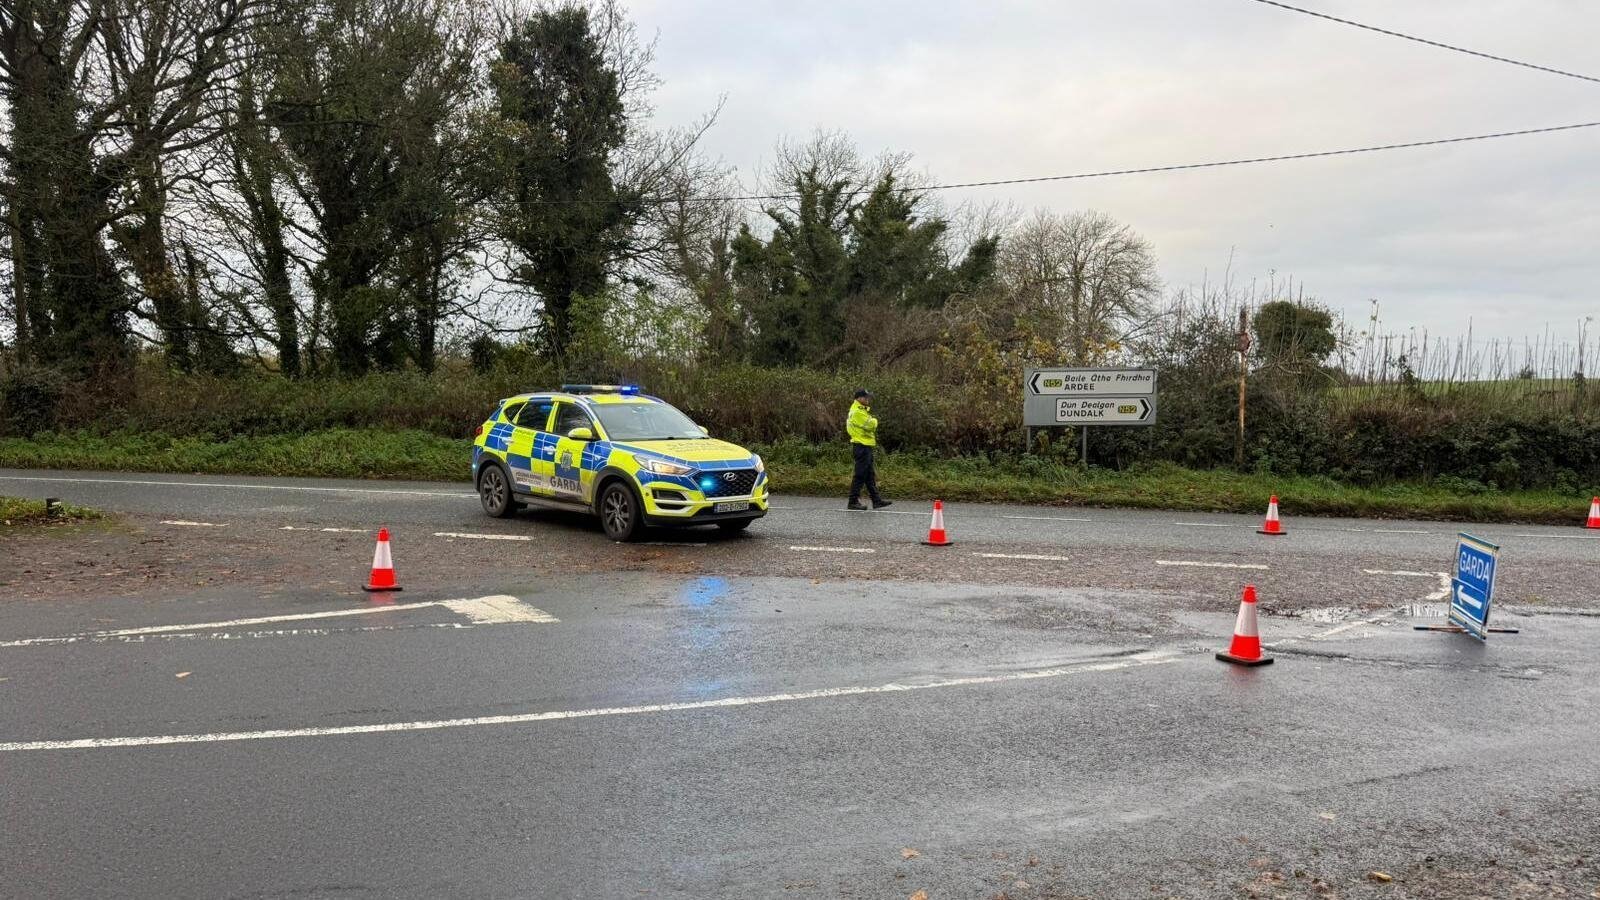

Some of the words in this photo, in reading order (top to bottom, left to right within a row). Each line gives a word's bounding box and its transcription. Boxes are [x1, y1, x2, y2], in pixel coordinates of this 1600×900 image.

[1064, 383, 1095, 391] ARDEE
[1060, 409, 1104, 417] DUNDALK
[550, 476, 583, 494] GARDA
[1460, 551, 1490, 581] GARDA
